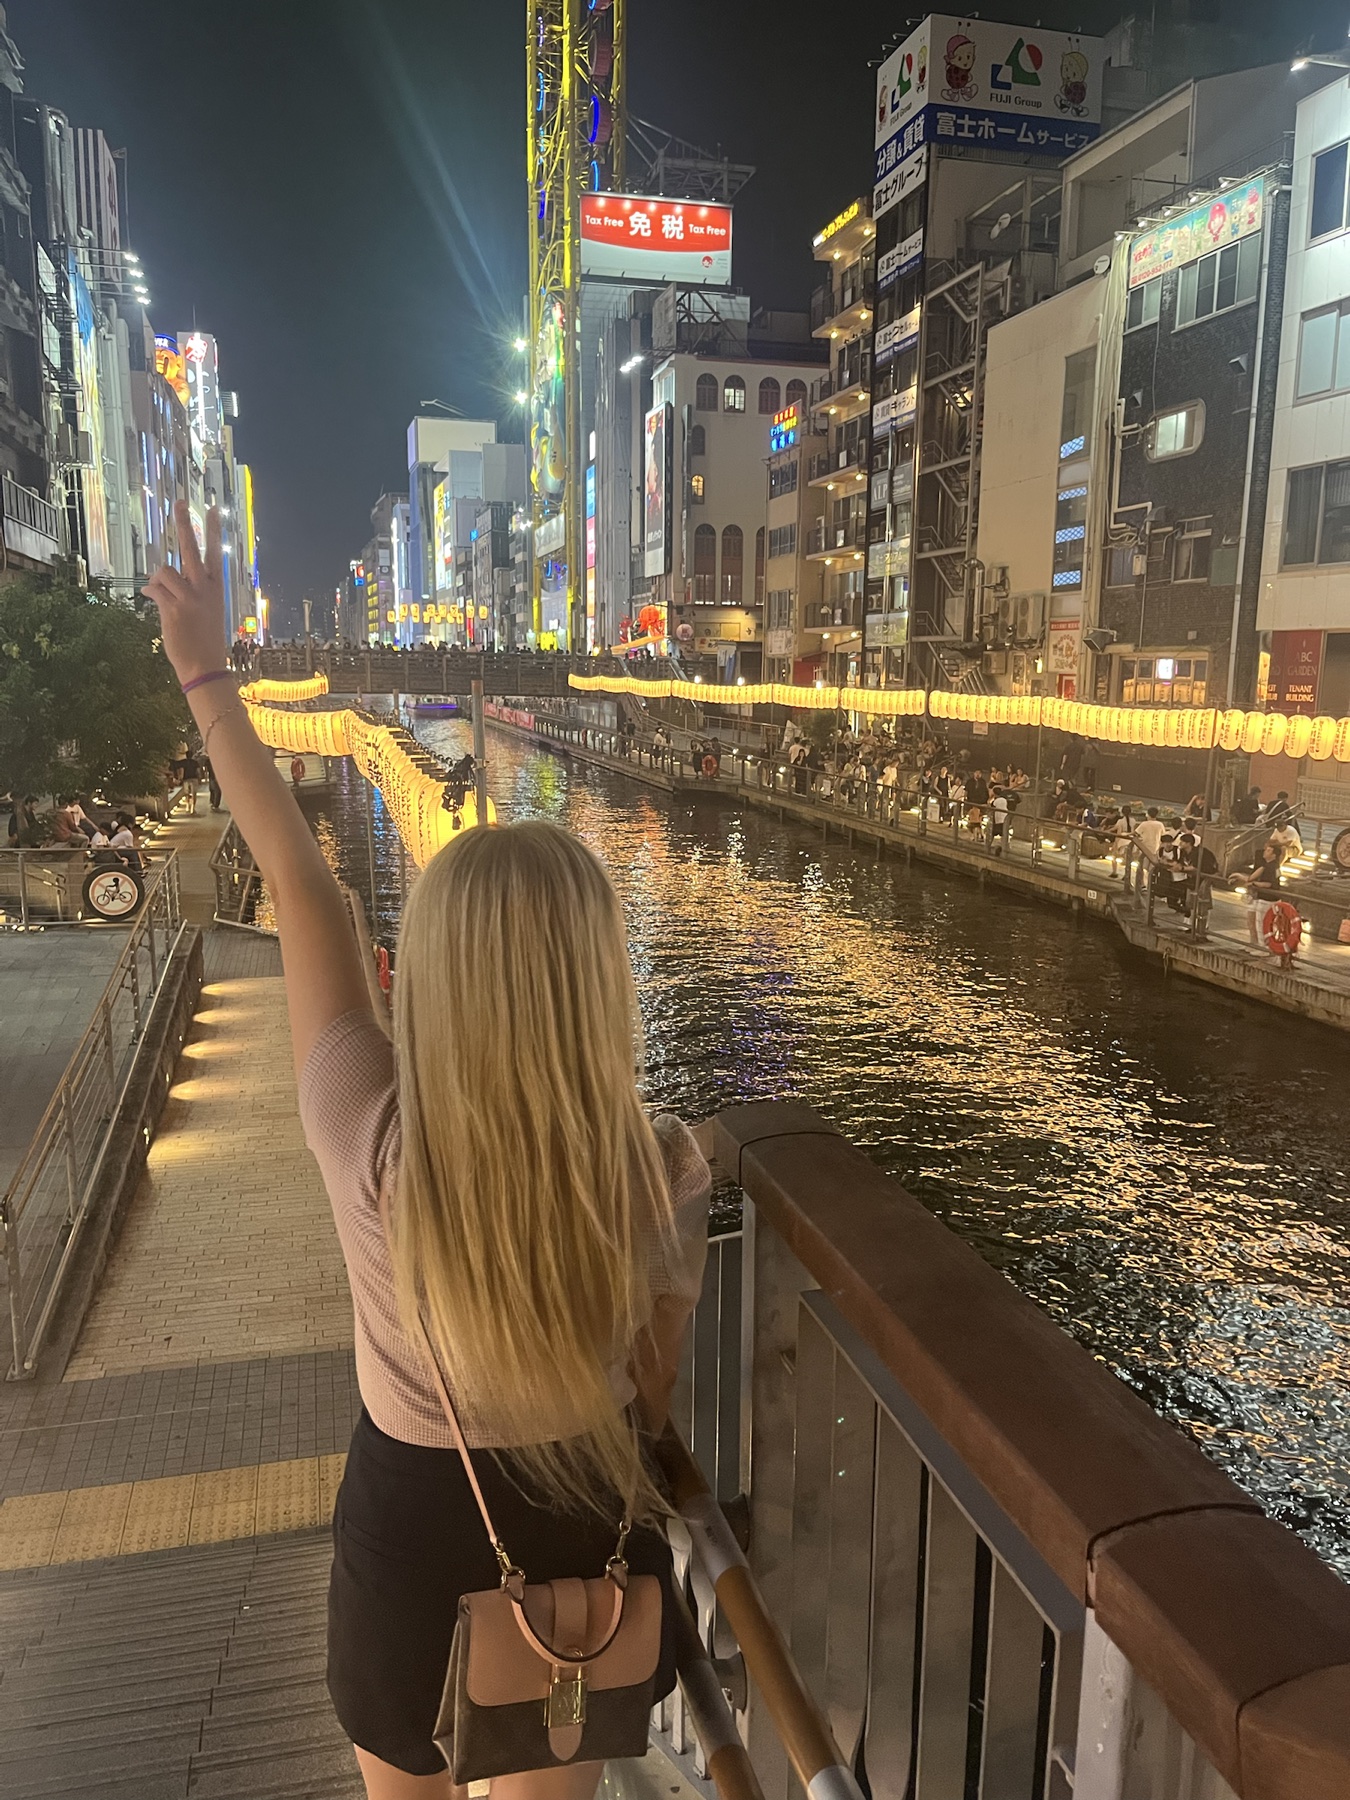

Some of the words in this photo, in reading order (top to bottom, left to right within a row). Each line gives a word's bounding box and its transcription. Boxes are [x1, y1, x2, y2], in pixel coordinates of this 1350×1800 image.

[990, 92, 1012, 105] FUJI
[1014, 95, 1043, 109] Group
[890, 113, 900, 126] FUJI
[900, 102, 912, 117] Group
[936, 111, 1090, 149] 富士ホームサービス
[875, 152, 924, 213] 富士グループ
[585, 214, 602, 226] Tax
[603, 216, 625, 228] Free
[628, 211, 685, 240] 免税
[688, 223, 705, 235] Tax
[706, 224, 727, 236] Free
[1287, 665, 1318, 676] GARDEN
[1285, 693, 1315, 703] BUILDING
[1288, 684, 1313, 693] TENANT
